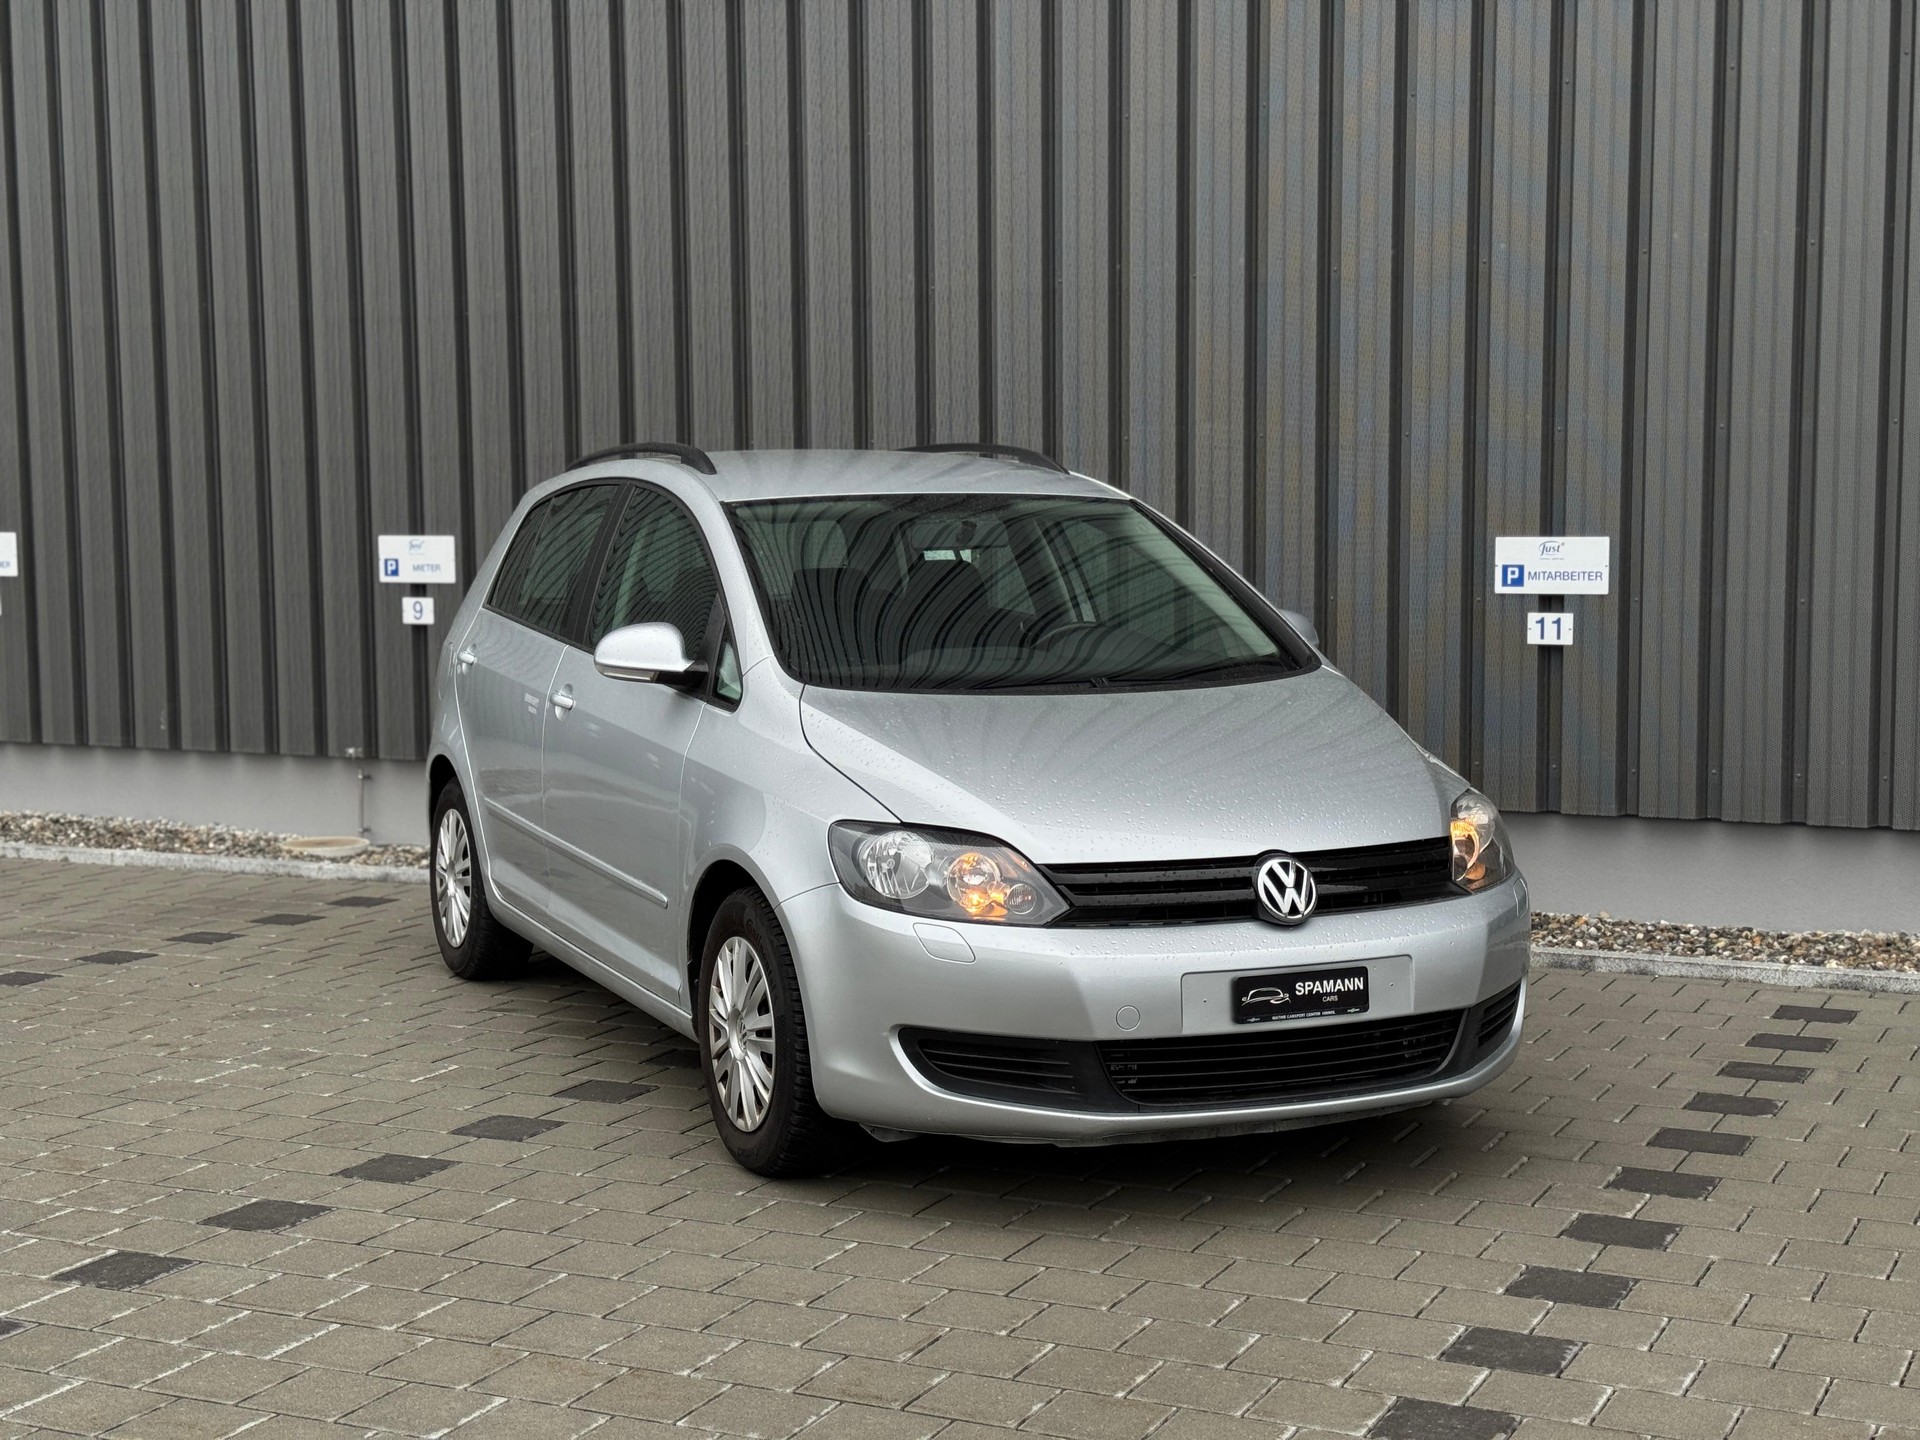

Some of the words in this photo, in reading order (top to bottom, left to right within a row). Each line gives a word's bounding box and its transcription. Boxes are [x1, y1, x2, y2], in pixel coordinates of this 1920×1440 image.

[387, 560, 397, 575] P
[412, 564, 441, 573] MIETER
[1507, 566, 1520, 585] P
[1528, 571, 1603, 581] MITARBEITER
[413, 600, 423, 620] 9
[1535, 617, 1562, 640] 11
[1259, 859, 1314, 916] VW
[1295, 976, 1364, 996] SPAMANN
